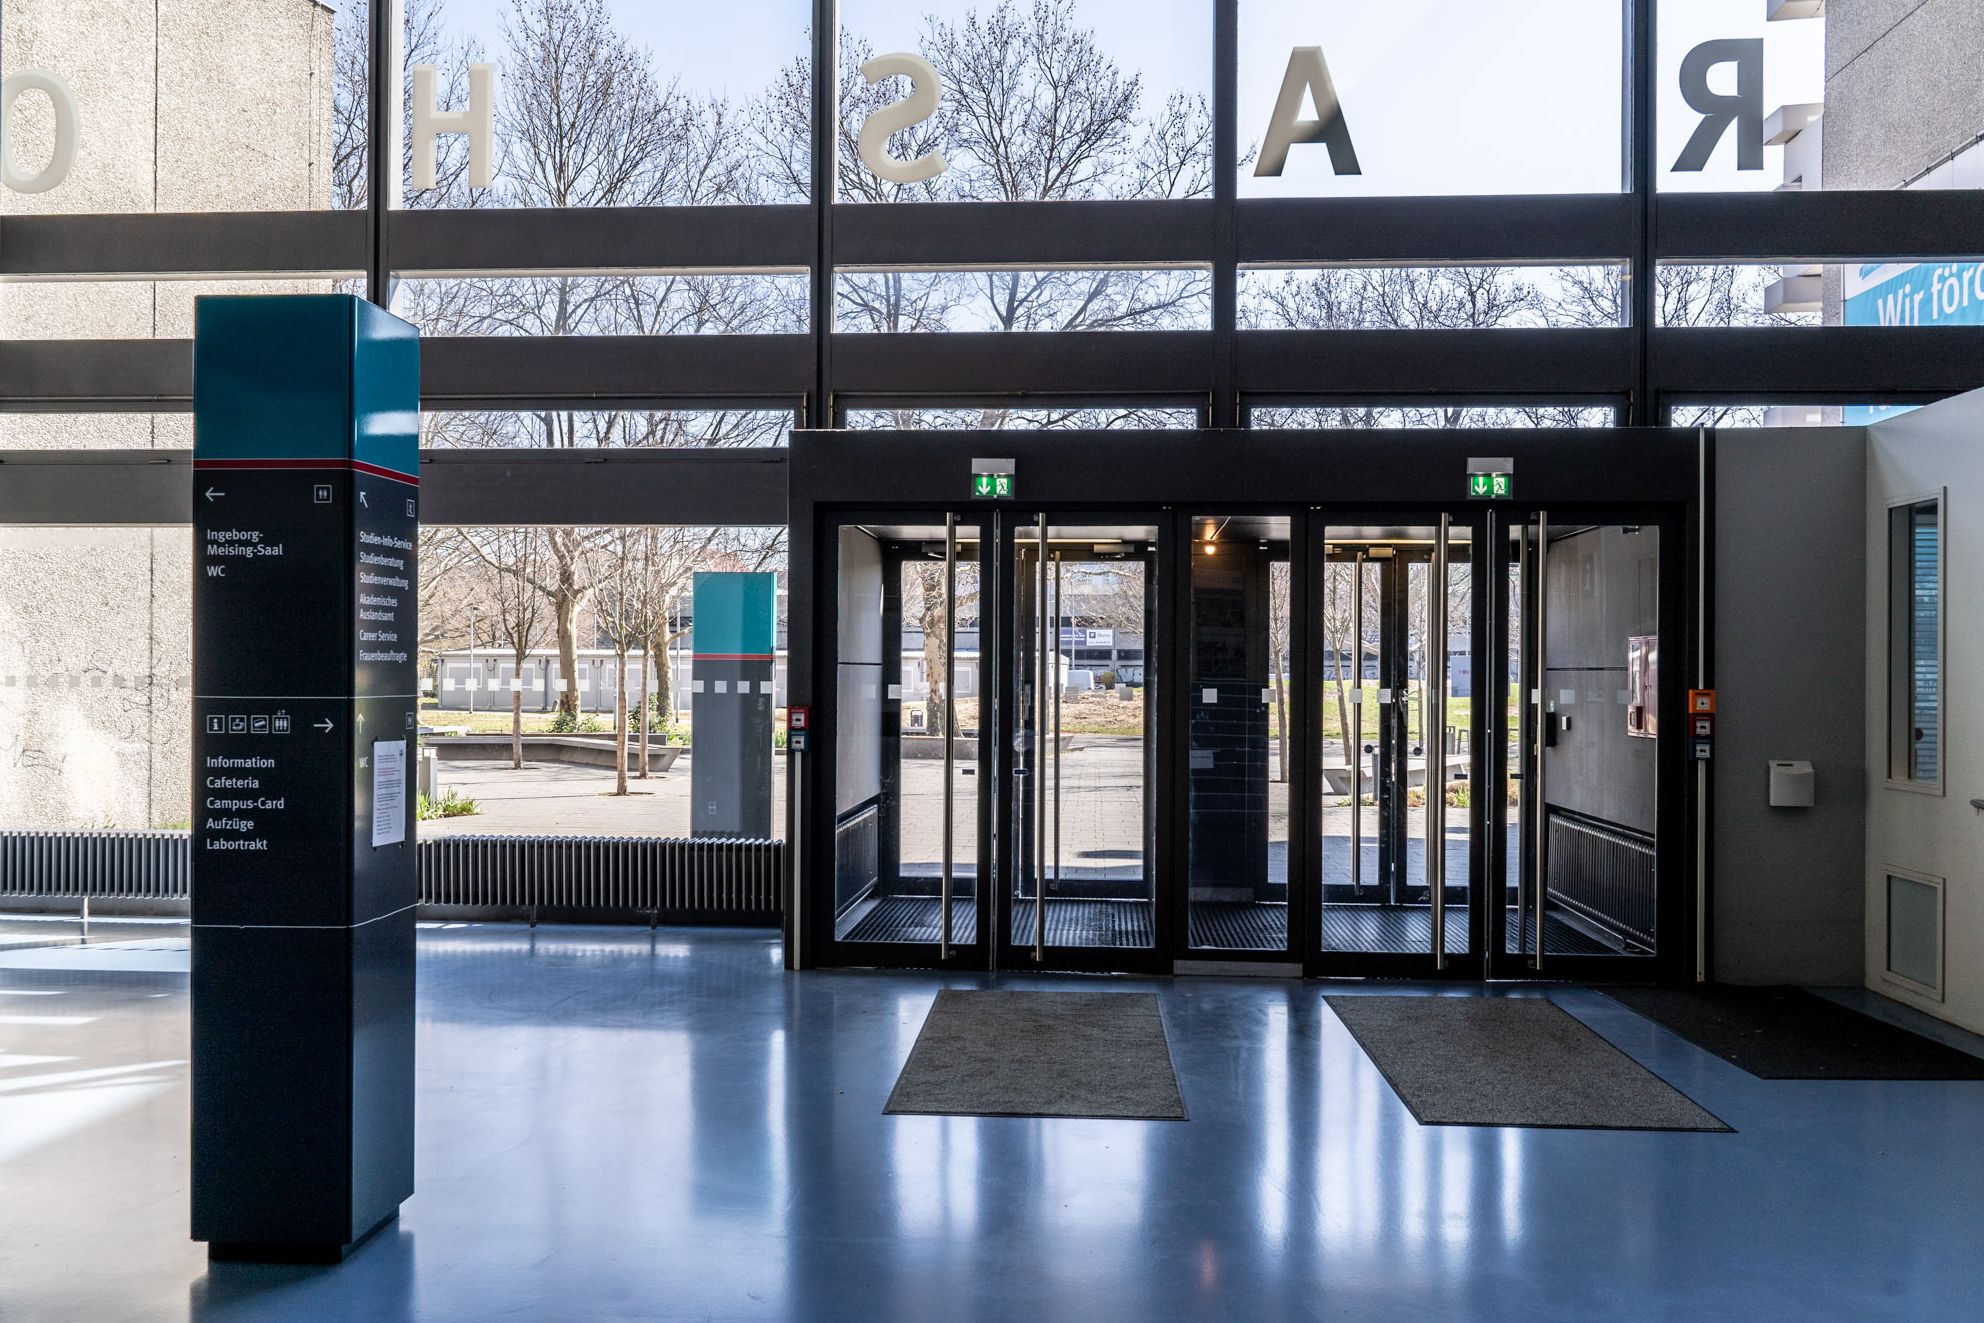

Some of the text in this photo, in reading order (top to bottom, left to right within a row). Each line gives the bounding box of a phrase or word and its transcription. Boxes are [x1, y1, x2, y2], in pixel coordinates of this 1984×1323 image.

[1877, 283, 1925, 327] Wir
[206, 528, 264, 542] Ingeborg-
[359, 531, 413, 551] Studien-Info-Service
[206, 544, 284, 558] Meising-Saal
[359, 551, 404, 571] Studienberatung
[206, 565, 226, 577] WC
[359, 571, 409, 590] Studienverwaltung
[359, 593, 398, 607] Akademisches
[359, 608, 395, 621] Auslandsamt
[359, 629, 398, 642] Career Service
[359, 649, 408, 664] Frauenbeauftragte
[206, 755, 275, 768] Information
[359, 756, 369, 769] WC
[206, 776, 260, 789] Cafeteria
[206, 797, 285, 811] Campus-Card
[206, 817, 255, 831] Aufzüge
[206, 838, 268, 850] Labortrakt
